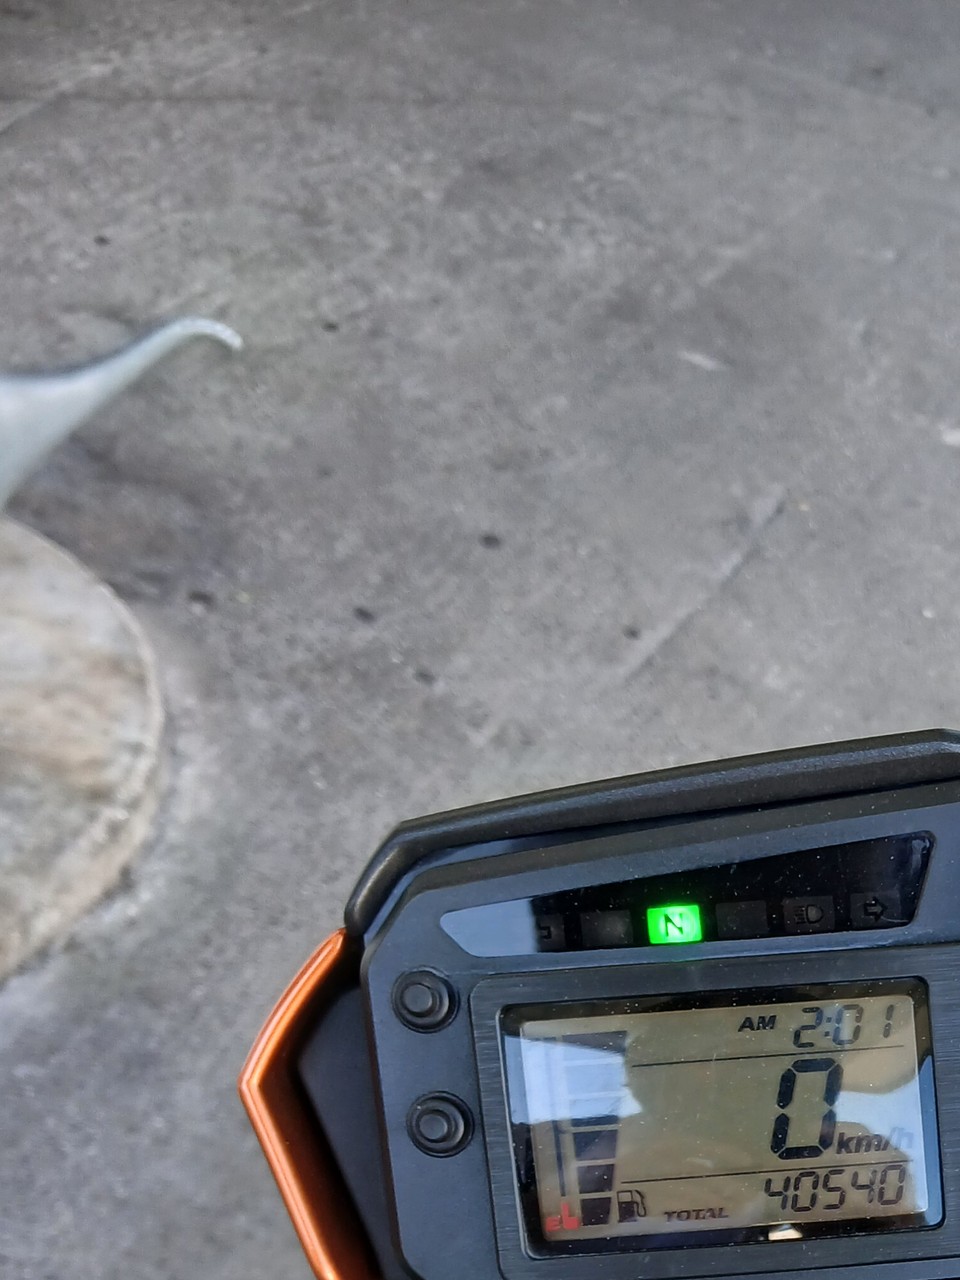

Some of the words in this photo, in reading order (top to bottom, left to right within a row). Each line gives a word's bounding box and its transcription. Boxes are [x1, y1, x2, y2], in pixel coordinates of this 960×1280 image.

[663, 912, 684, 937] N
[738, 1015, 777, 1032] AM
[793, 1003, 895, 1048] 2:01
[770, 1057, 844, 1160] 0
[836, 1127, 914, 1155] km/h
[663, 1206, 729, 1222] TOTAL
[764, 1164, 906, 1212] 40540
